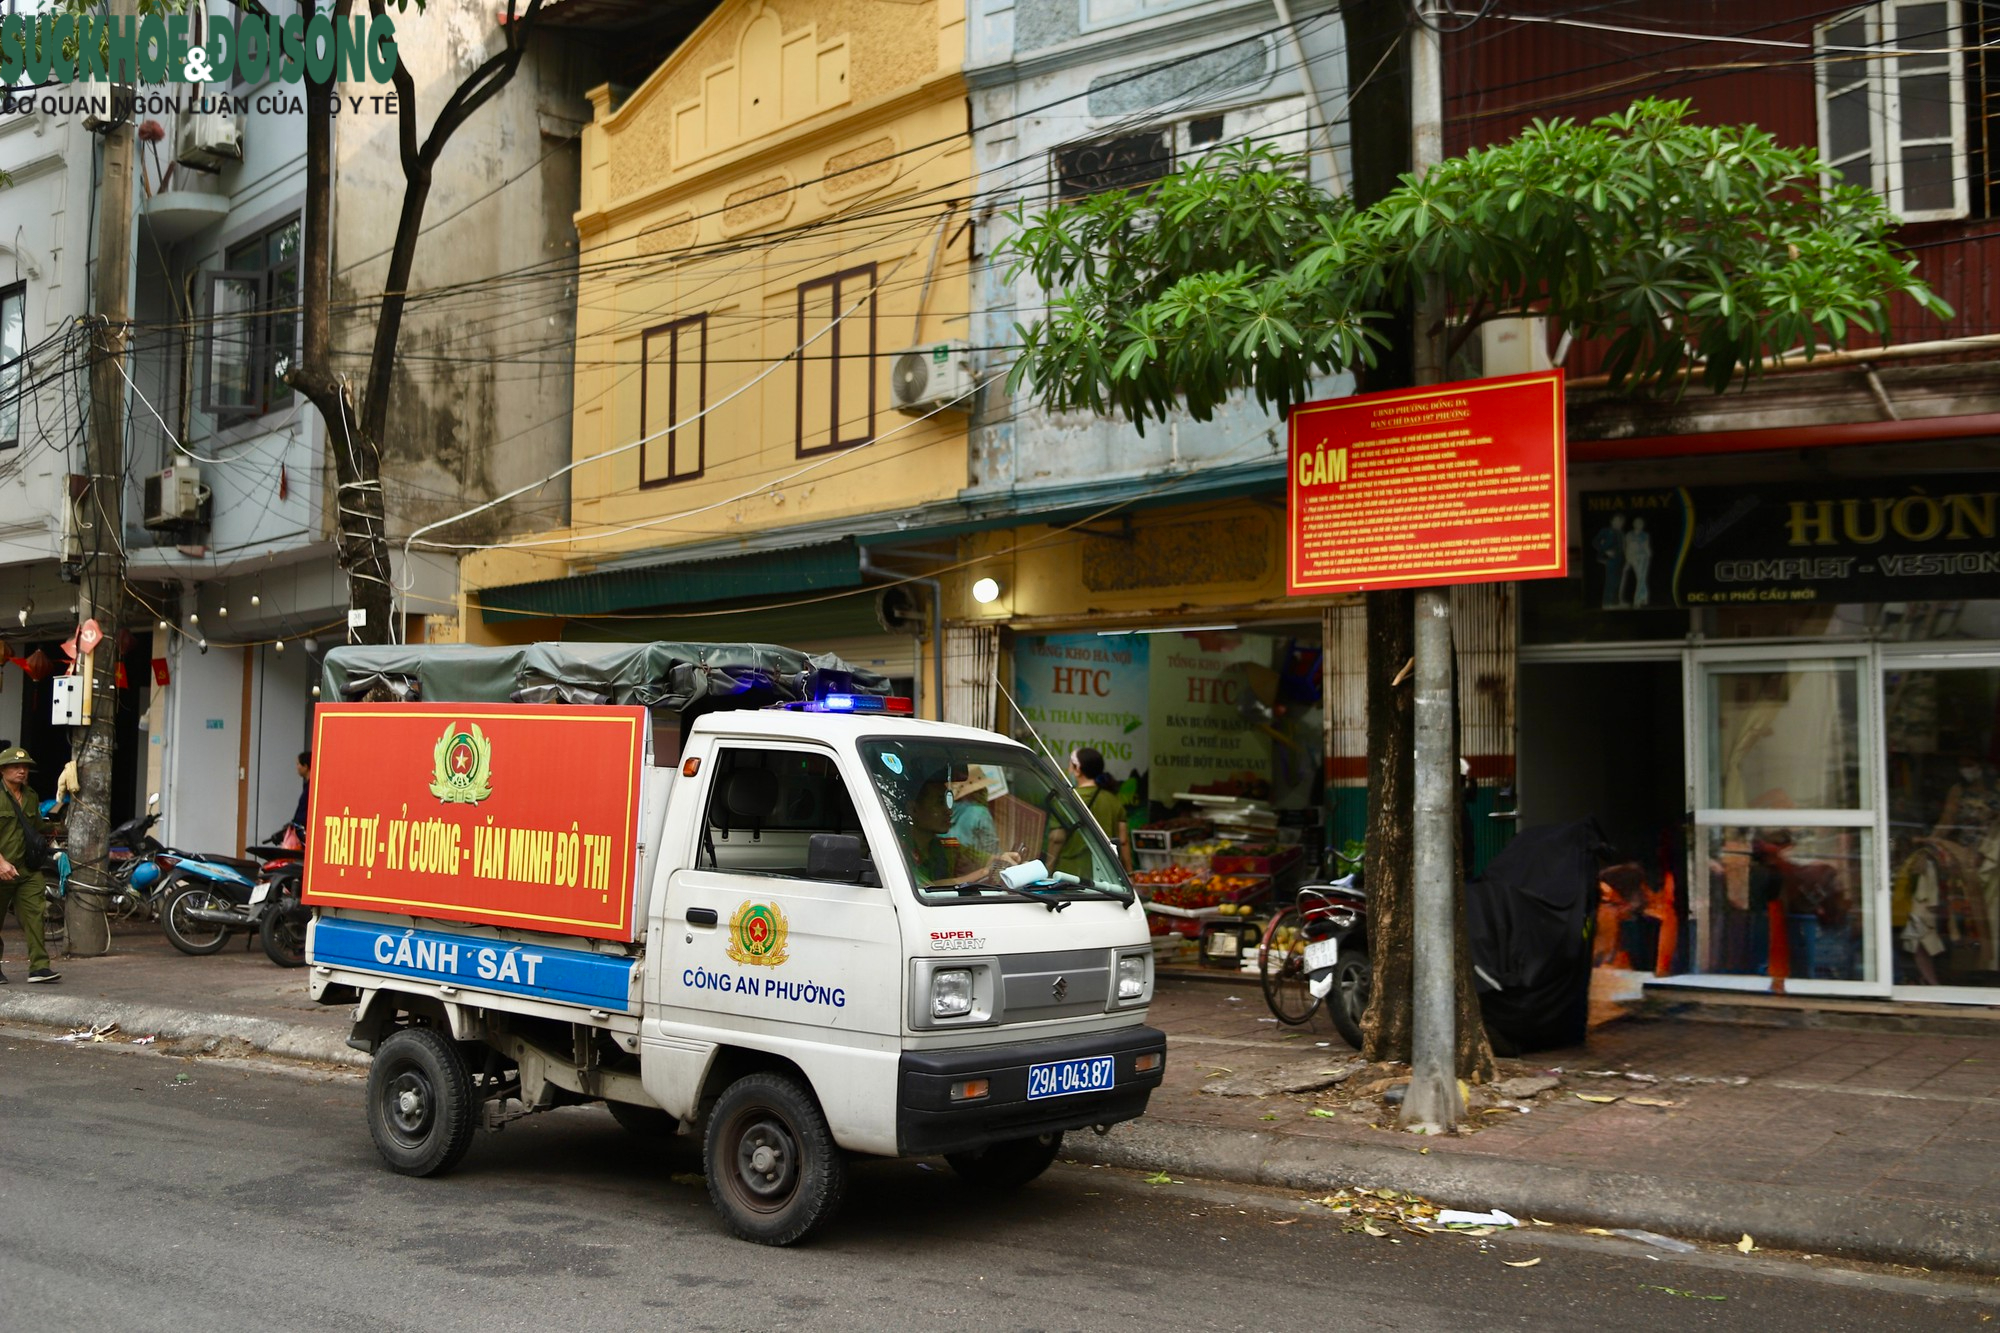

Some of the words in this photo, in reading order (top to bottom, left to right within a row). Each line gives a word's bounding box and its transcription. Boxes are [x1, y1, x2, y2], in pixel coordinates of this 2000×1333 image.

[1299, 437, 1348, 487] CẤM
[1714, 555, 1857, 583] COMPLET
[1052, 666, 1111, 697] HTC
[1187, 676, 1237, 705] HTC
[1050, 707, 1082, 725] THÁI
[324, 806, 359, 877] TRẬT
[359, 813, 380, 879] TỰ
[387, 802, 408, 870] KỶ
[409, 816, 461, 876] CƯƠNG
[473, 815, 507, 880] VĂN
[507, 828, 554, 885] MINH
[554, 820, 580, 888] ĐÔ
[583, 833, 612, 904] THỊ
[930, 931, 974, 940] SUPER
[931, 937, 987, 951] CARRY
[374, 929, 459, 975] CẢNH
[477, 946, 544, 986] SÁT
[683, 966, 732, 992] CÔNG
[735, 976, 760, 996] AN
[765, 979, 846, 1008] PHƯỜNG
[1030, 1059, 1111, 1096] 29A-043.87
